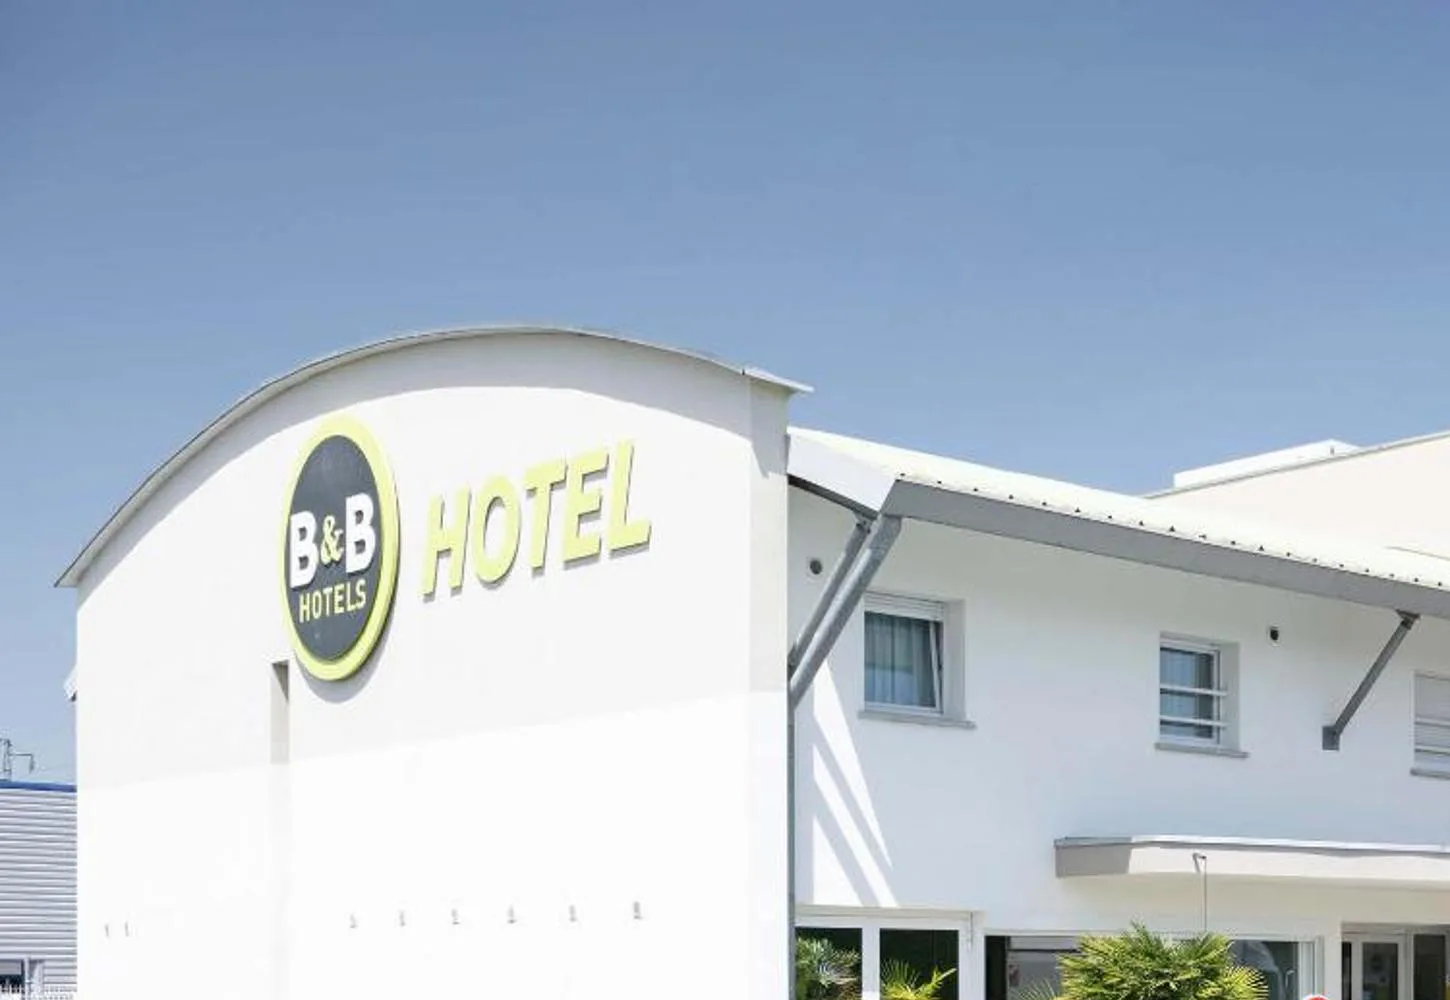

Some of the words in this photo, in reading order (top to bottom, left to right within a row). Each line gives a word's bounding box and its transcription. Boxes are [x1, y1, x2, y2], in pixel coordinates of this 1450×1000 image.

[289, 492, 376, 589] B&B
[421, 440, 651, 600] HOTEL
[299, 578, 367, 624] HOTELS
